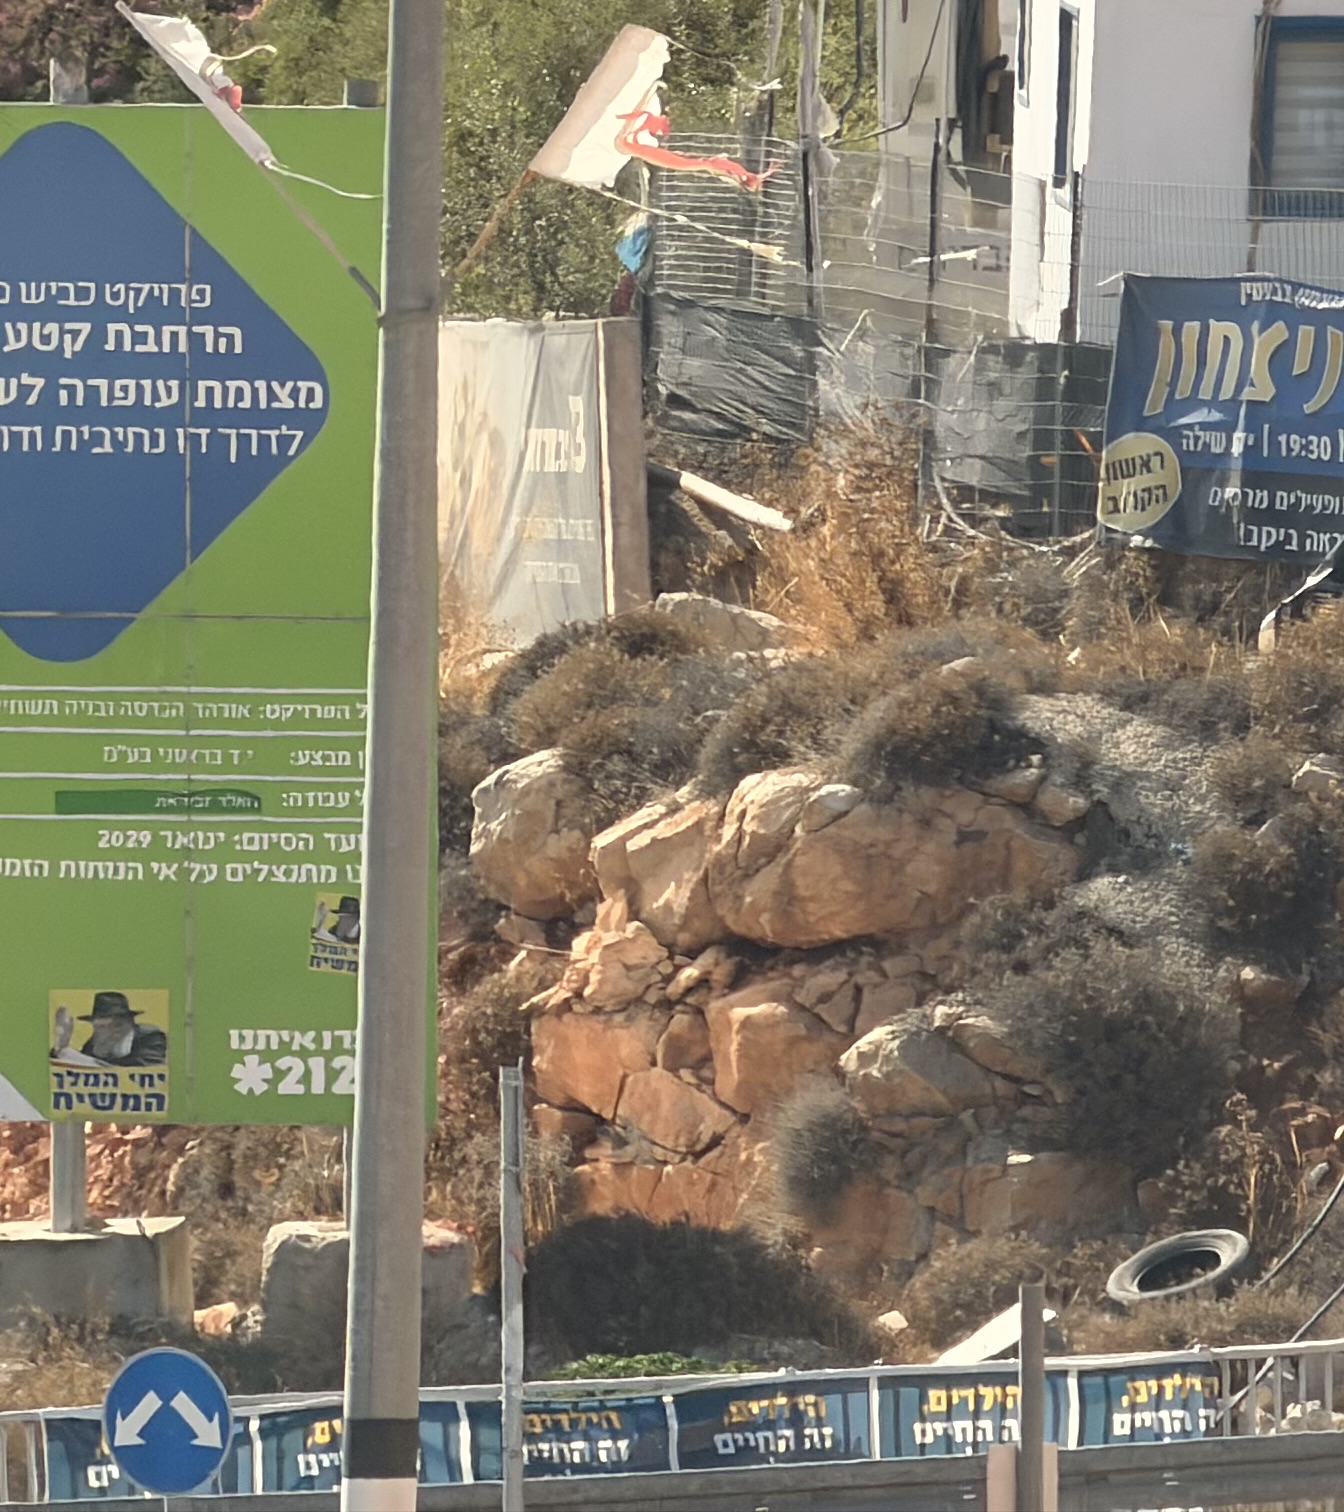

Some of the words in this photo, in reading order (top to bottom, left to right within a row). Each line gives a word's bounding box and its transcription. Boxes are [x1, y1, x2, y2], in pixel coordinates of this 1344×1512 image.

[20, 282, 96, 306] כביש
[104, 283, 212, 313] פרויקט
[2, 322, 92, 359] קטע
[104, 323, 243, 355] הרחבת
[1142, 319, 1344, 417] ניצחון
[58, 377, 180, 408] עופרה
[194, 379, 324, 410] מצומת
[51, 425, 165, 455] נתיבית
[175, 427, 211, 455] דו
[217, 424, 304, 463] לדרך
[1182, 425, 1227, 454] שילה
[1277, 434, 1332, 462] 19:30
[1105, 451, 1165, 486] ראשון
[65, 700, 114, 717] ובניה
[120, 700, 184, 718] הנדסה
[258, 703, 350, 721] הפרויקט:
[290, 749, 352, 766] מבצע:
[281, 791, 350, 808] עבודה:
[97, 829, 153, 849] 2029
[158, 830, 226, 850] ינואר
[233, 832, 314, 852] הסיום:
[58, 859, 144, 881] הנוחות
[150, 862, 179, 882] אי
[225, 860, 338, 883] מתנצלים
[229, 1029, 317, 1051] איתנו
[52, 1070, 119, 1089] המלך
[128, 1073, 166, 1088] יחי
[53, 1092, 166, 1112] המשיח
[713, 1430, 795, 1455] החיים
[803, 1427, 834, 1451] זה
